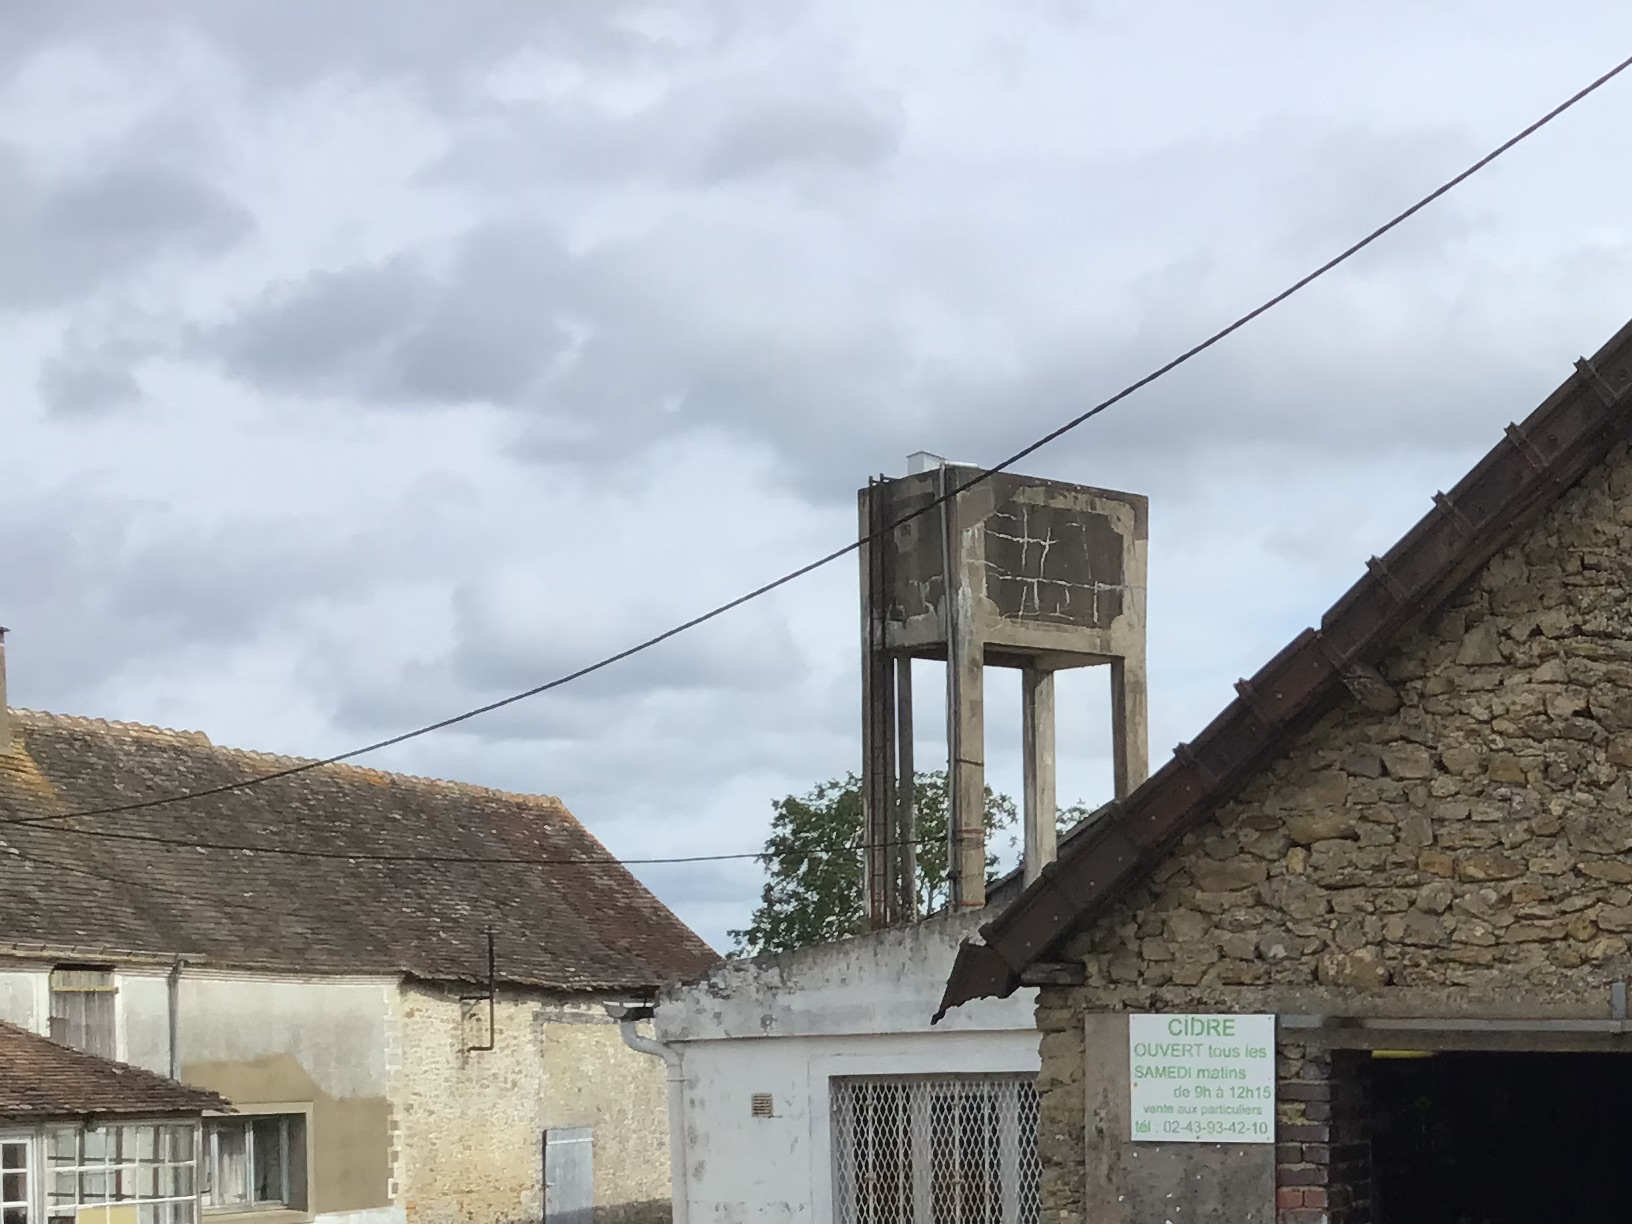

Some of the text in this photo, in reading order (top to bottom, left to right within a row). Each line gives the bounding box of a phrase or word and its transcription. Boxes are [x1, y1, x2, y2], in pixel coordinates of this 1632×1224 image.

[1168, 1018, 1235, 1037] CIDRE
[1134, 1043, 1267, 1058] OUVERT tous les
[1134, 1065, 1246, 1080] SAMEDI matins
[1173, 1085, 1271, 1099] de 9h à 12h15
[1143, 1104, 1263, 1116] vente aux particuliers
[1135, 1120, 1151, 1133] tél
[1163, 1121, 1268, 1134] 02-43-93-42-10
